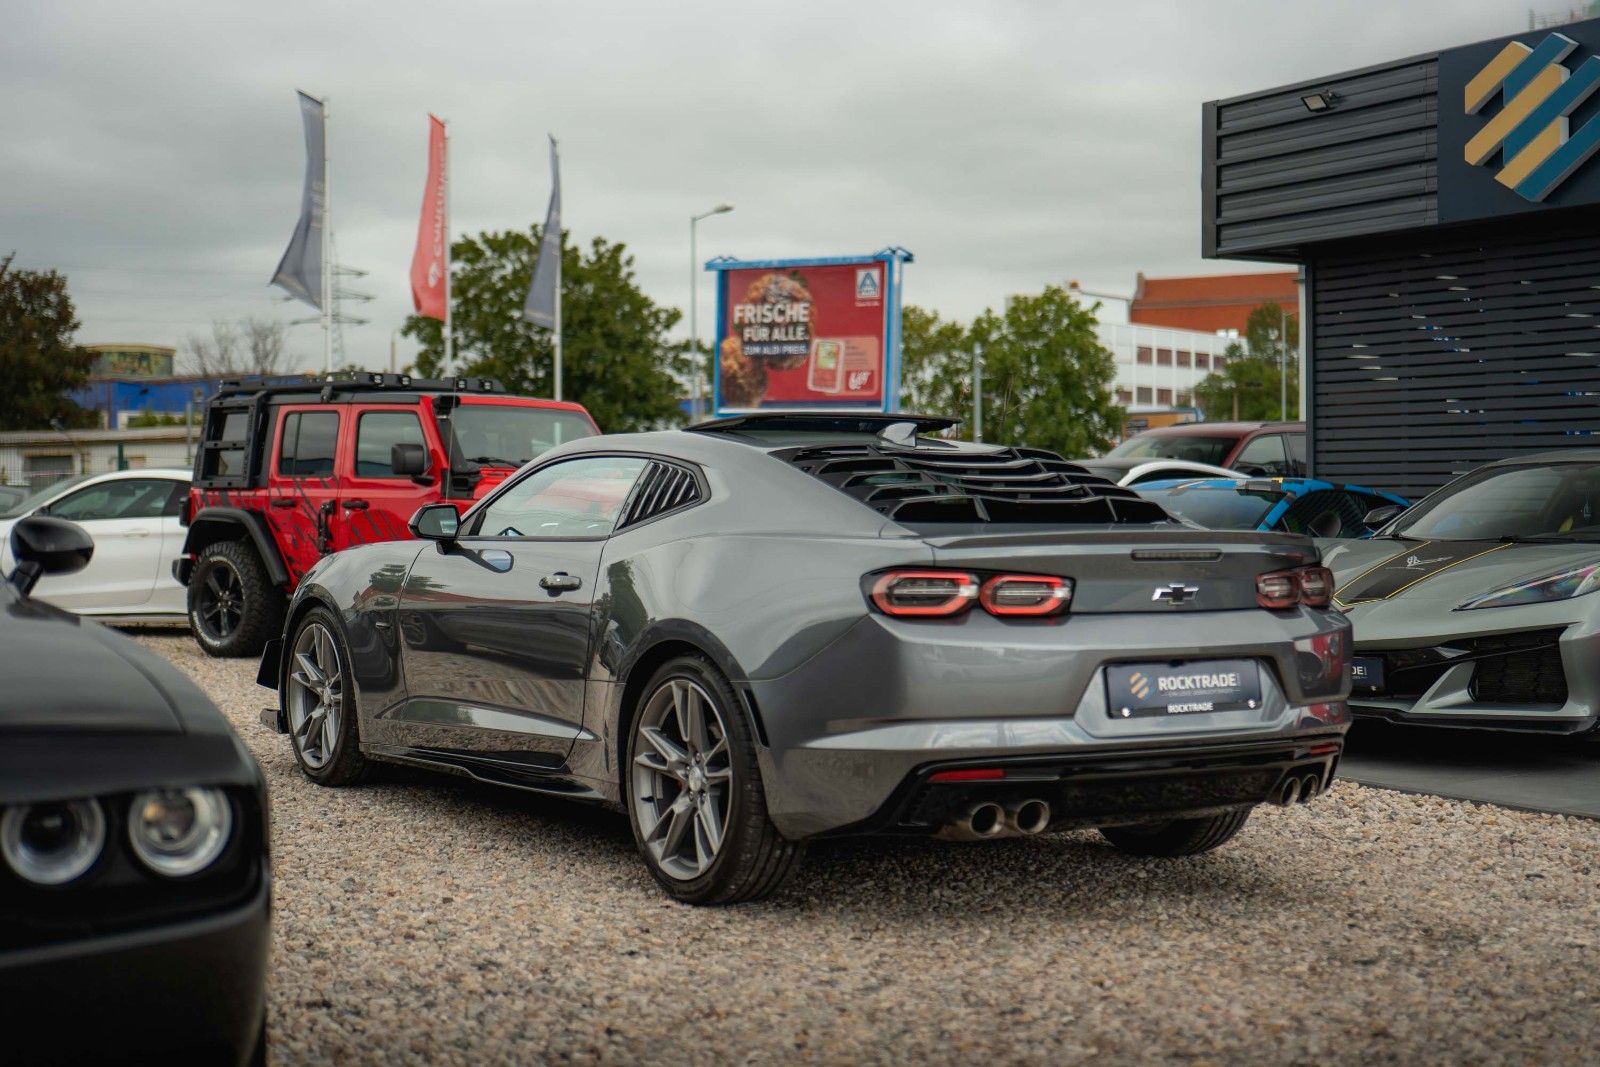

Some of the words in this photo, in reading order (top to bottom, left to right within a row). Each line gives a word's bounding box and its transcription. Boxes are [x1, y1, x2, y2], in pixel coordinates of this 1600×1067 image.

[734, 302, 810, 324] FRISCHE
[743, 324, 769, 342] FÜR
[1158, 673, 1237, 691] ROCKTRADE
[1167, 702, 1214, 714] ROCKTRADE
